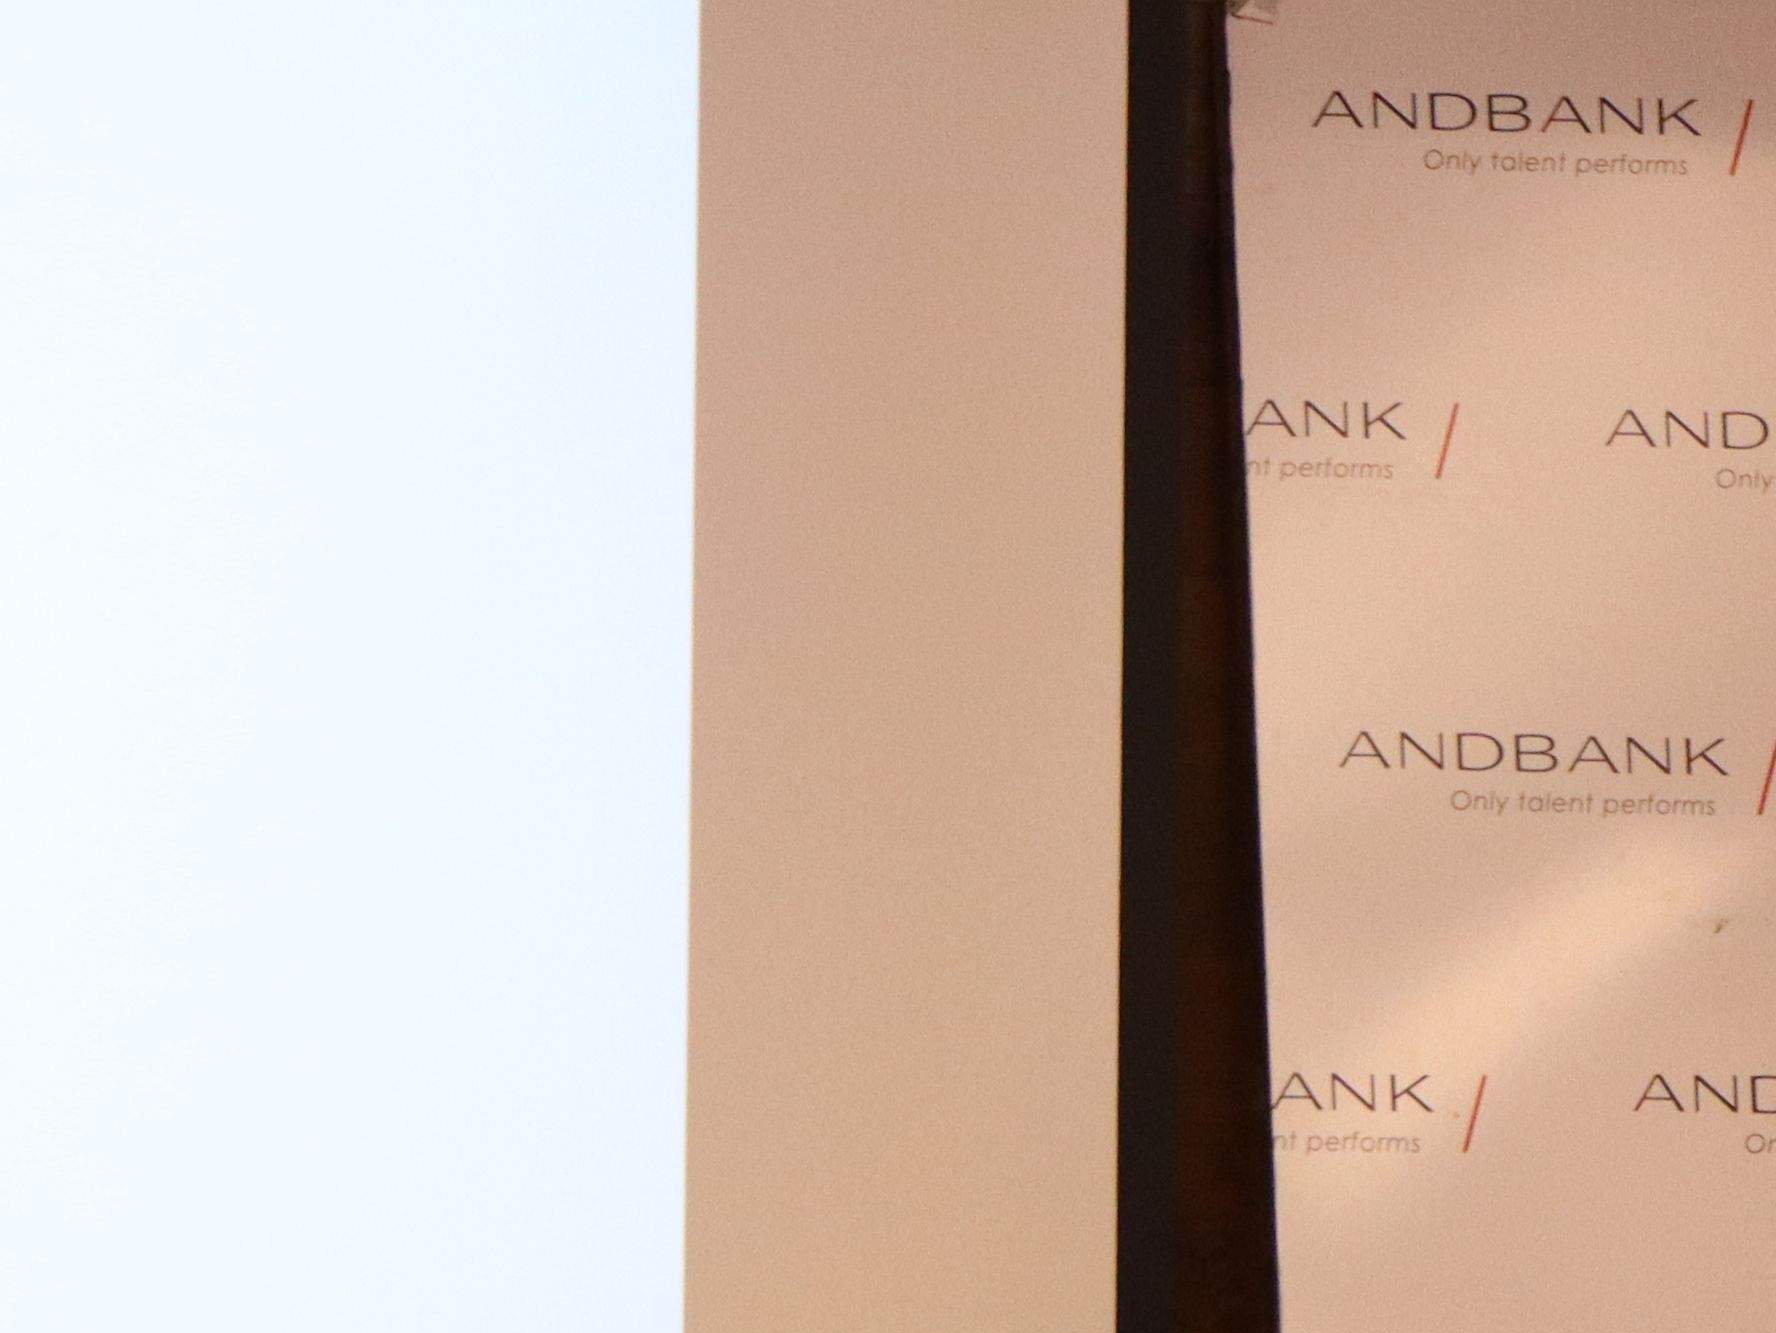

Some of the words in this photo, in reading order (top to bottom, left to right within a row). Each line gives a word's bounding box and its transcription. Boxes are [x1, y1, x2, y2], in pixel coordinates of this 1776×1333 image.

[1311, 89, 1702, 137] ANDBANK
[1422, 147, 1480, 176] Only
[1490, 151, 1568, 173] talent
[1574, 151, 1689, 177] performs
[1246, 399, 1407, 440] ANK
[1605, 409, 1769, 450] AND
[1280, 455, 1394, 481] performs
[1716, 467, 1774, 493] Only
[1338, 730, 1729, 777] ANDBANK
[1449, 789, 1509, 816] Only
[1518, 790, 1595, 814] talent
[1602, 792, 1717, 819] performs
[1270, 1071, 1435, 1112] ANK
[1306, 1130, 1421, 1155] performs
